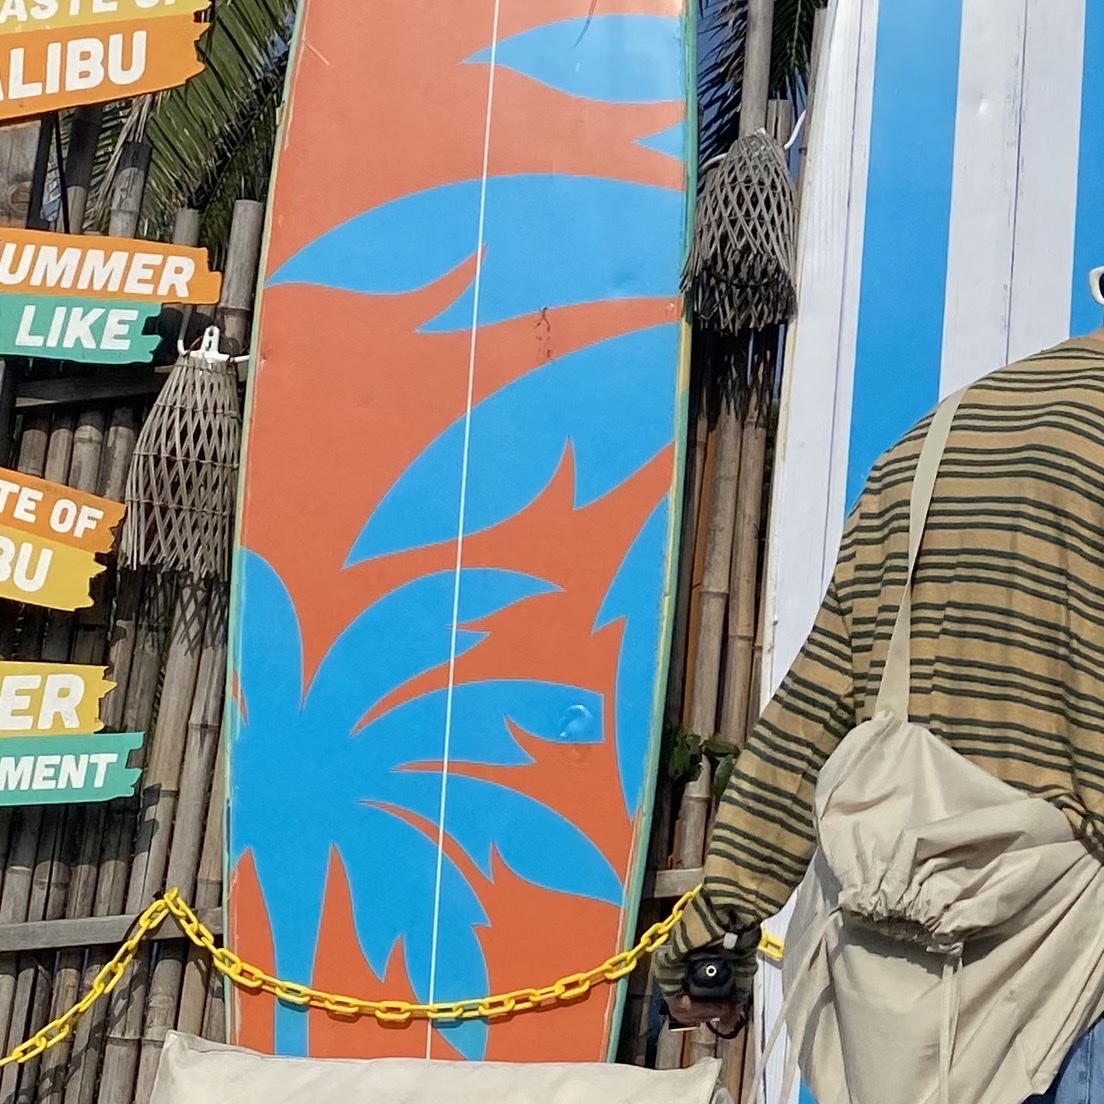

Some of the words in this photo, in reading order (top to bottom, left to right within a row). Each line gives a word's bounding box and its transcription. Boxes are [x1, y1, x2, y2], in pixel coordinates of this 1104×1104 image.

[0, 31, 147, 100] LIBU
[0, 243, 196, 298] UMMER
[15, 305, 139, 350] LIKE
[50, 500, 104, 538] OF
[0, 674, 85, 731] ER
[0, 753, 119, 791] MENT
